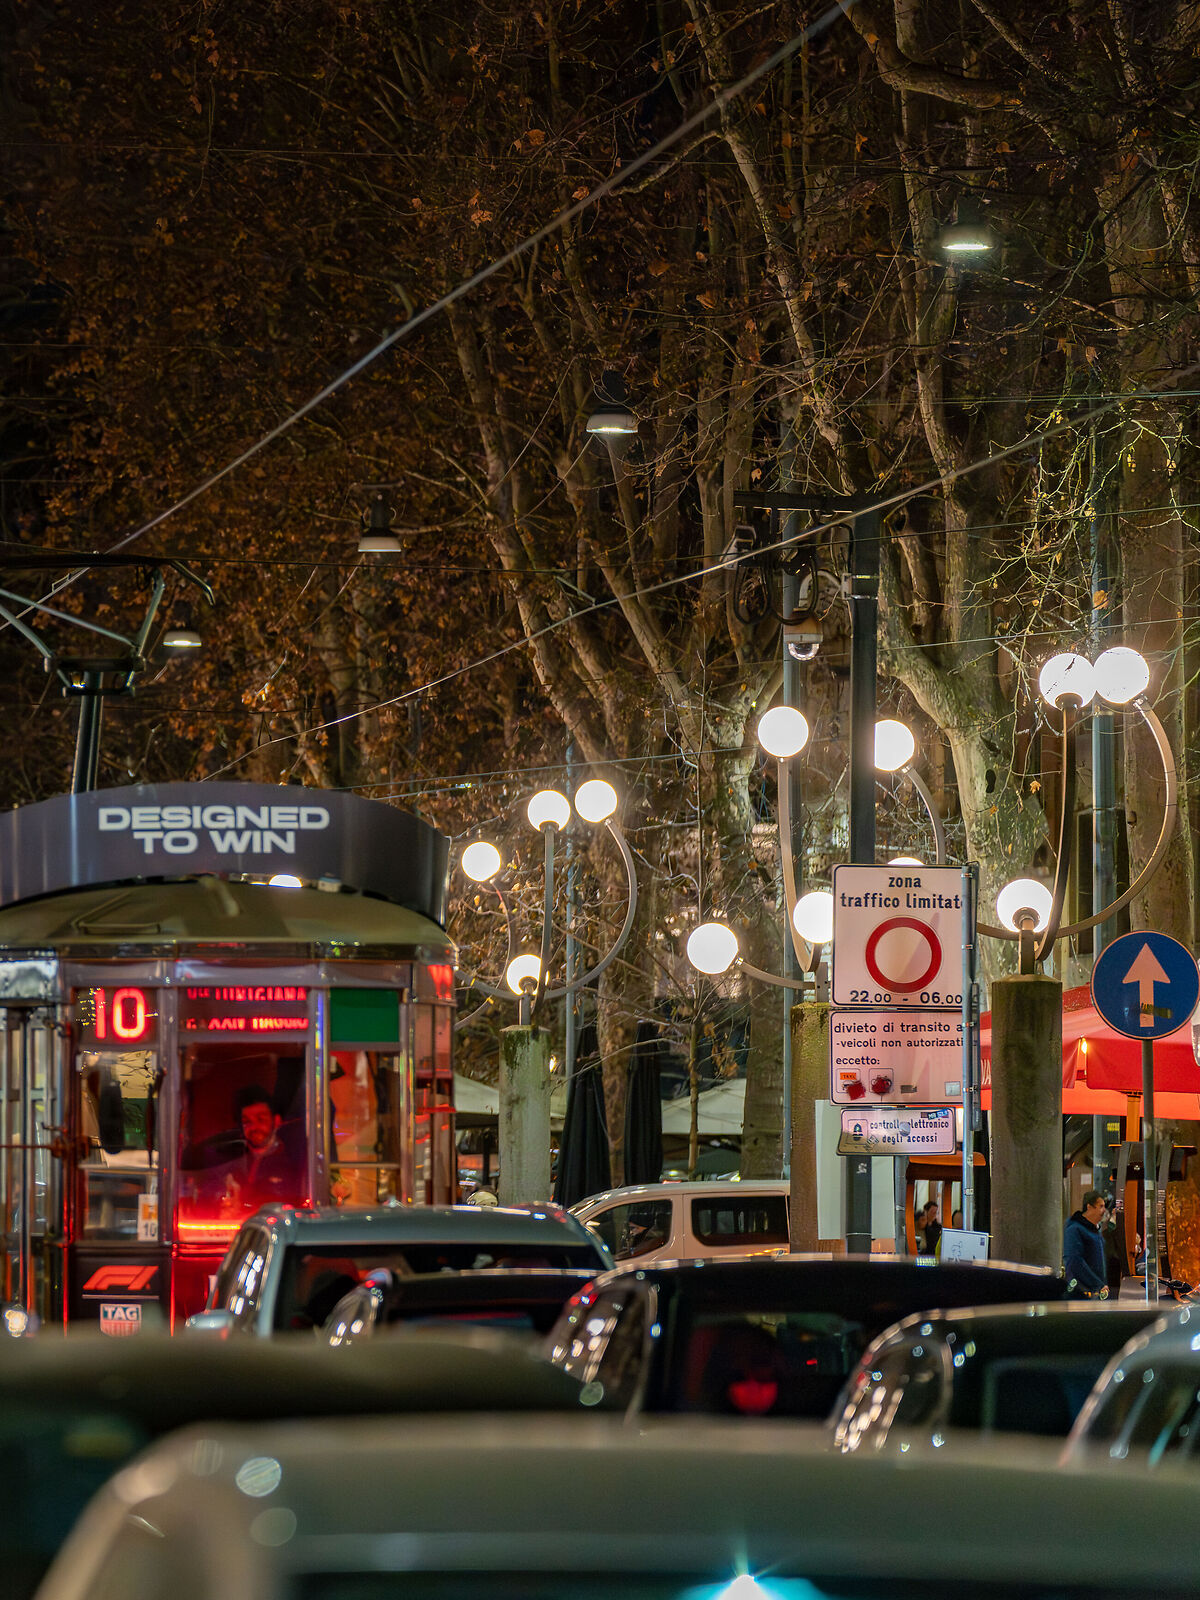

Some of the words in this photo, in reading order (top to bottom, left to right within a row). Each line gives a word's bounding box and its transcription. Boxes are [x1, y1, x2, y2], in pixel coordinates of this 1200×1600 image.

[99, 806, 330, 831] DESIGNED
[133, 830, 198, 854] TO
[209, 830, 295, 854] WIN
[888, 876, 921, 888] zona
[840, 892, 900, 908] traffico
[906, 893, 962, 909] limitat
[849, 990, 892, 1003] 22.00
[920, 991, 963, 1005] 06.00
[94, 987, 145, 1039] 10
[834, 1022, 877, 1033] divieto
[883, 1022, 894, 1033] di
[900, 1022, 951, 1033] transito
[881, 1040, 902, 1048] non
[906, 1038, 964, 1048] autorizzati
[836, 1056, 880, 1065] eccetto:
[870, 1119, 902, 1130] controll
[905, 1119, 949, 1129] lettronico
[882, 1133, 903, 1145] degli
[907, 1132, 938, 1143] accessi
[103, 1306, 138, 1321] TAG
